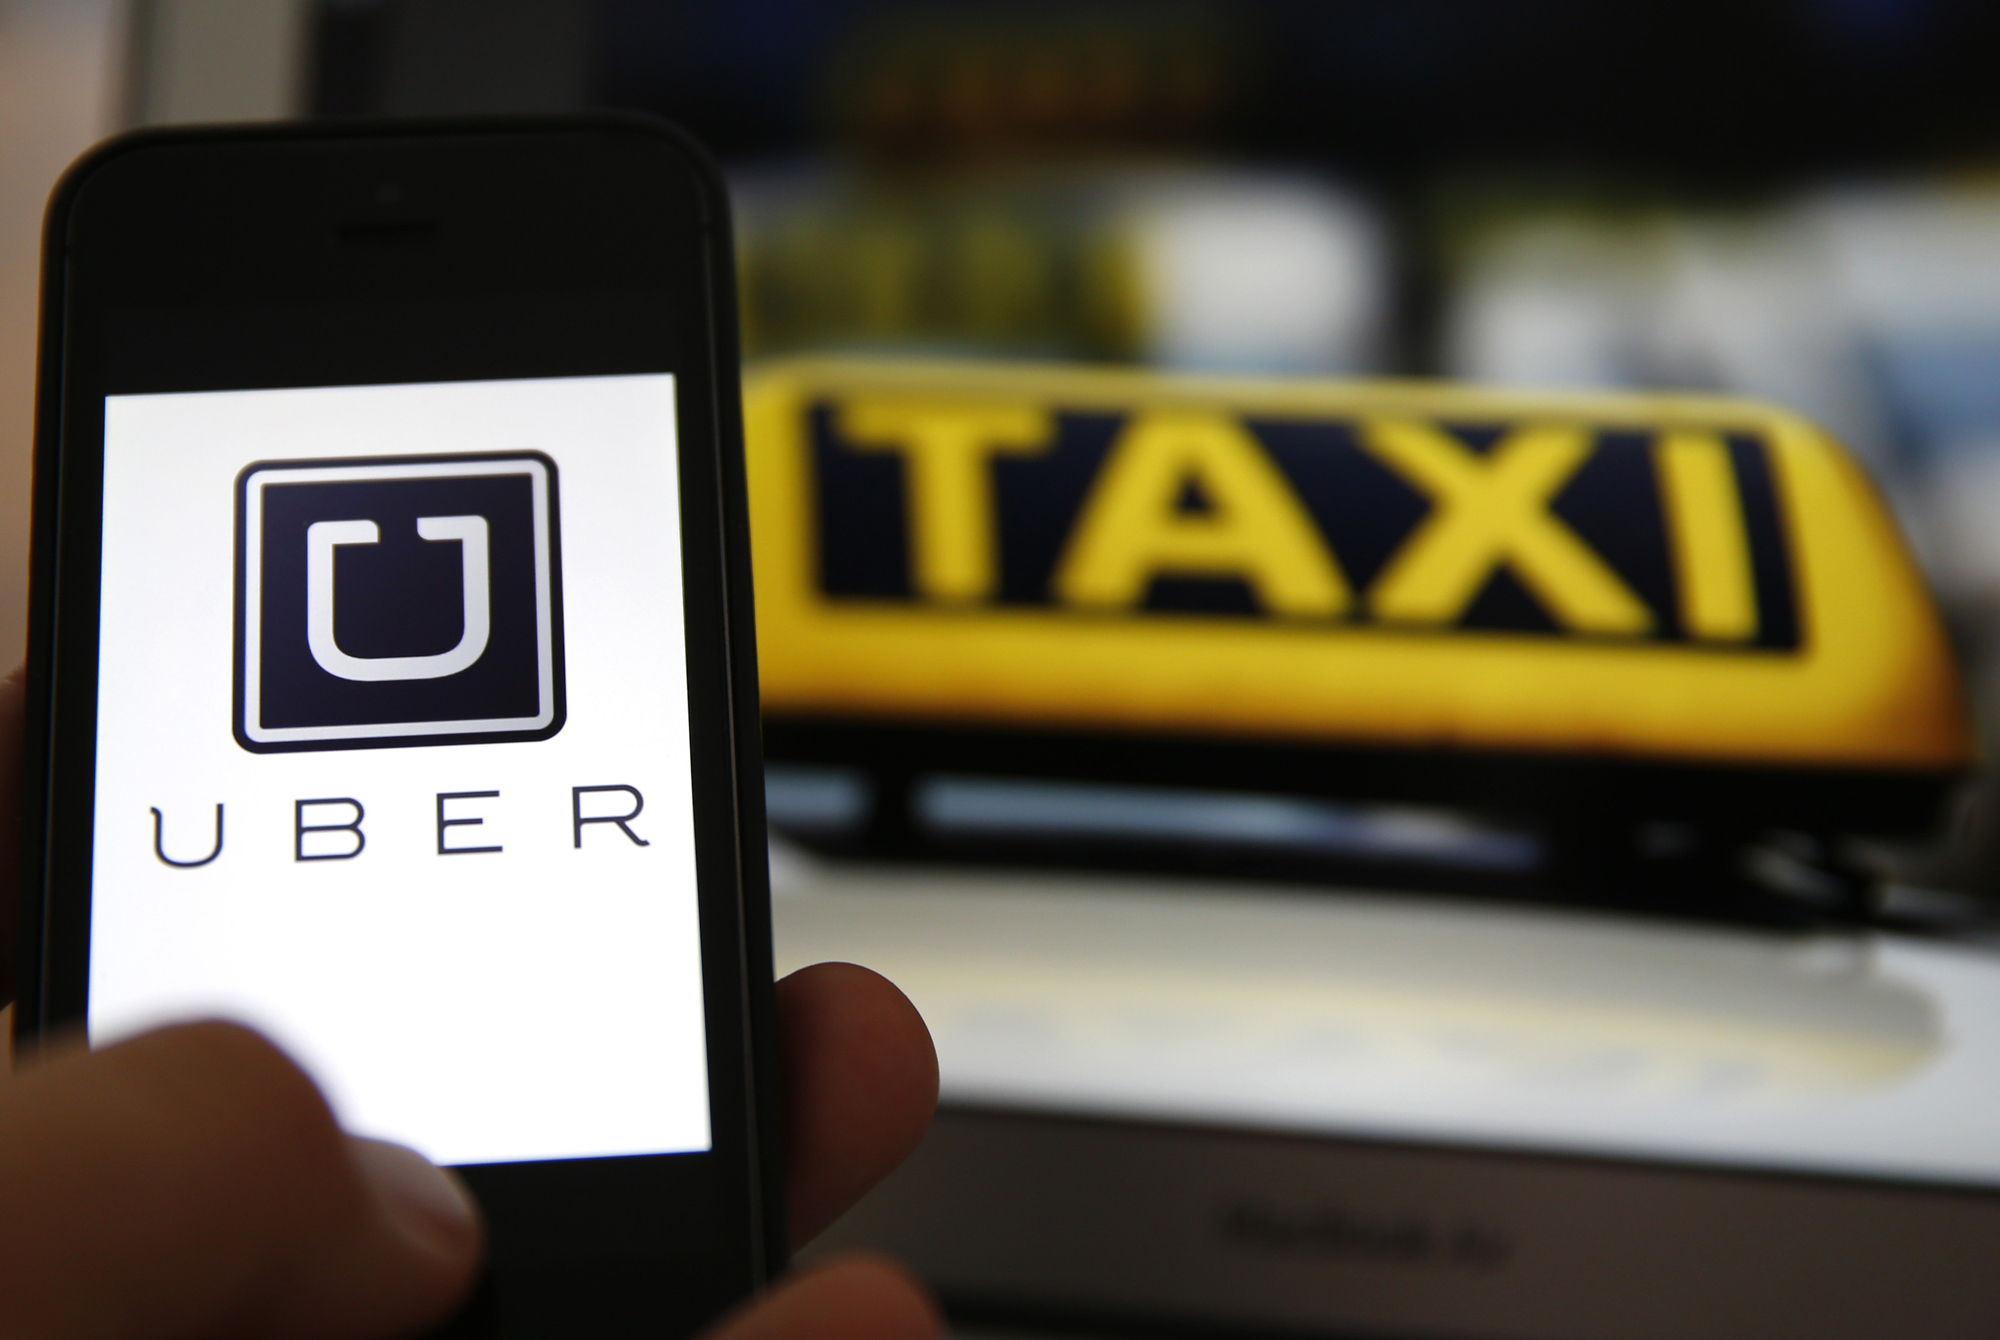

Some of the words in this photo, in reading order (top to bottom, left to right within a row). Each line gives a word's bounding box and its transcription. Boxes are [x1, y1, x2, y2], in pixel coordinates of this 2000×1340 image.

[307, 515, 490, 682] U
[831, 402, 1760, 641] TAXI
[150, 784, 650, 869] UBER
